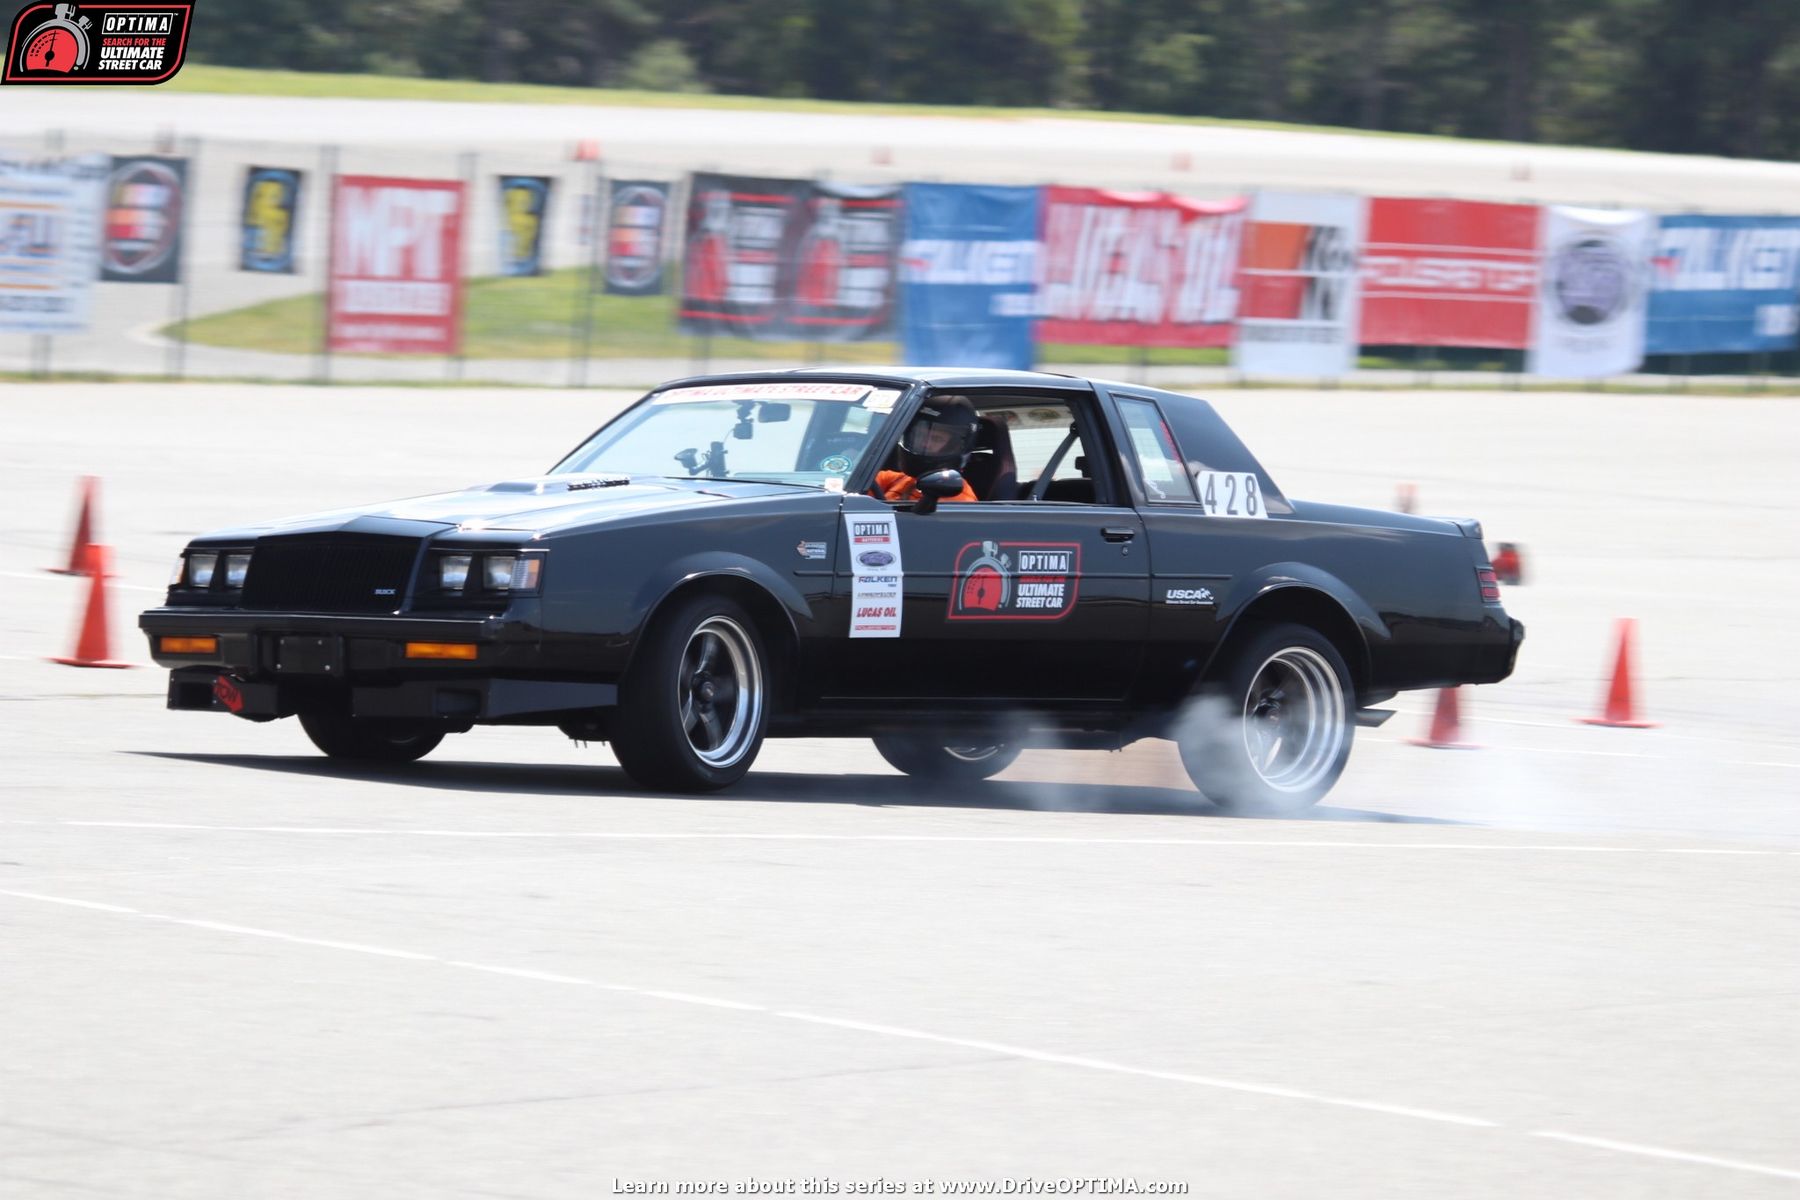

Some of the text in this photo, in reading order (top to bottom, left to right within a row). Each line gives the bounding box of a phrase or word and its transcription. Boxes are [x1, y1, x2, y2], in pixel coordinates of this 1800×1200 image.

[1205, 474, 1257, 516] 428
[855, 524, 889, 535] OPTIMA
[1021, 555, 1066, 570] OPTIMA
[1018, 584, 1065, 597] ULTIMATE
[1167, 589, 1202, 599] USCA
[1016, 597, 1063, 608] STREET CAR
[857, 607, 897, 618] LUCAS OIL
